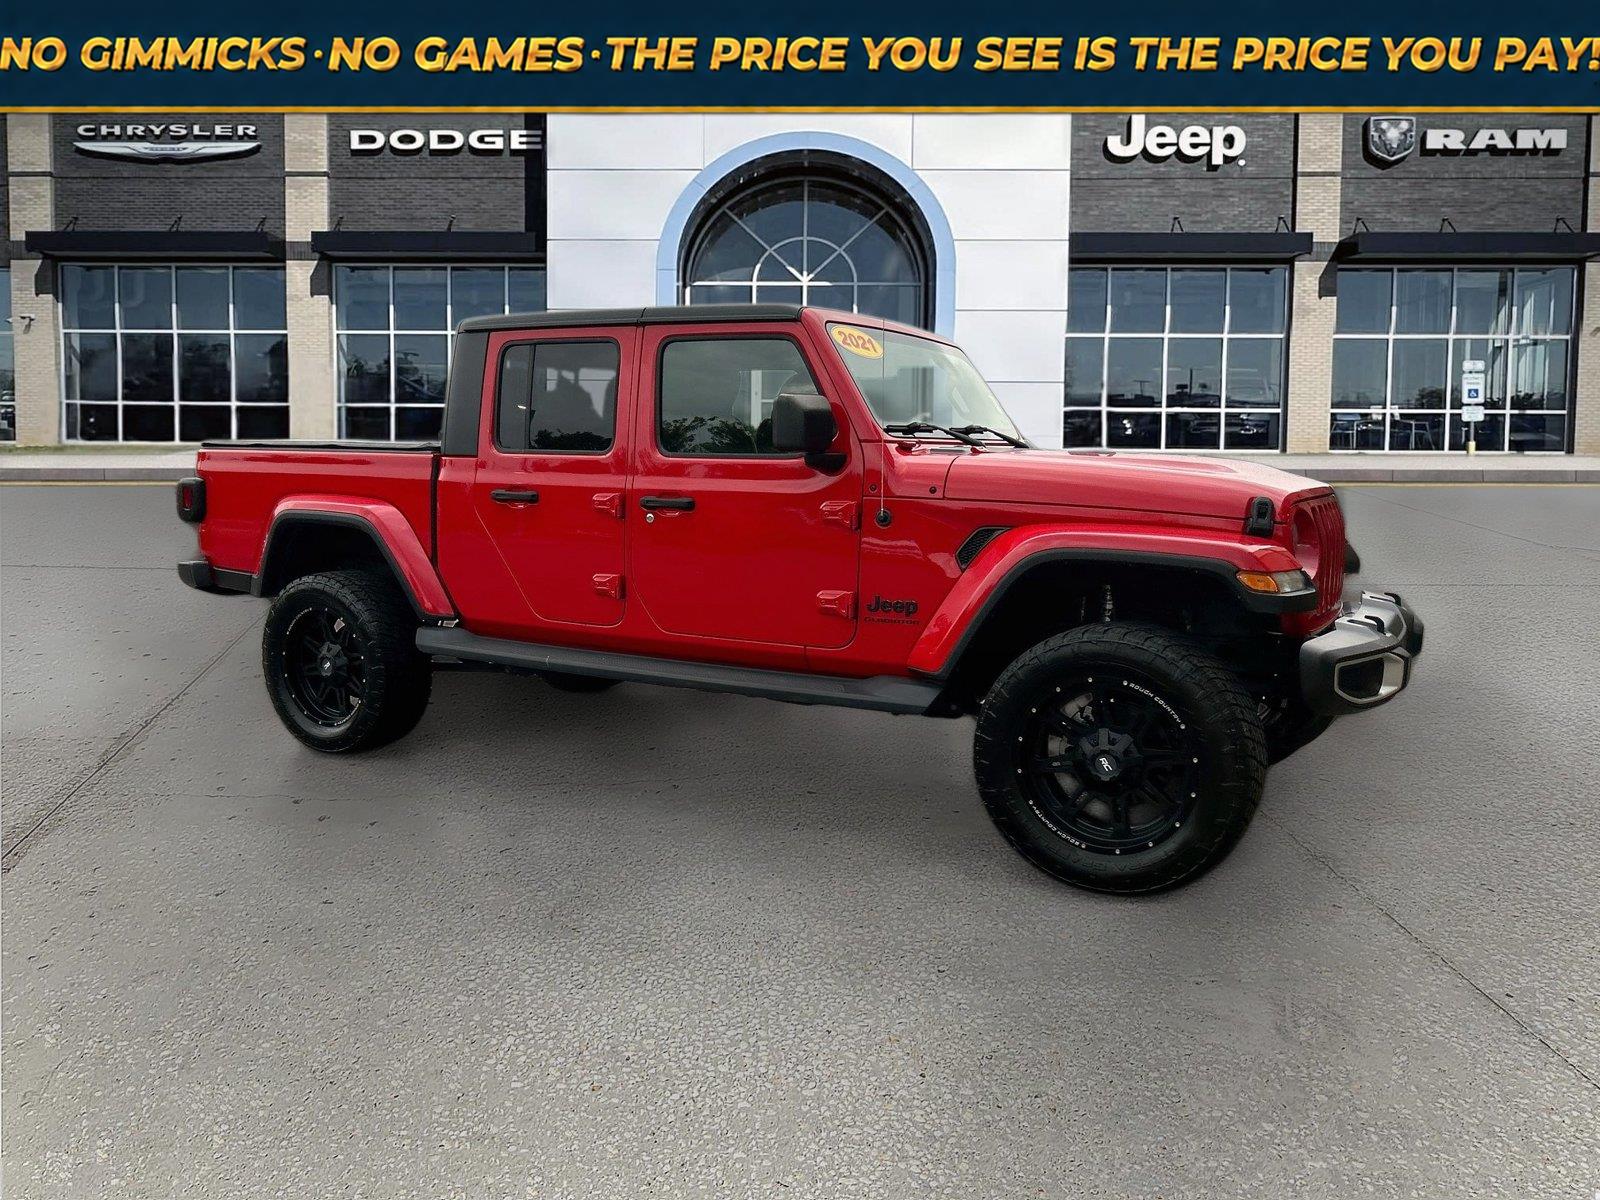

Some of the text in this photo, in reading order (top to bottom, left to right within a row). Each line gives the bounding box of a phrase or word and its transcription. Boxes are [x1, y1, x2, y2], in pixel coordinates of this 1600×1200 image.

[77, 124, 257, 136] CHRYSLER
[350, 129, 543, 151] DODGE
[1106, 114, 1247, 165] Jeep
[1425, 128, 1568, 150] RAM
[837, 330, 879, 353] 2021
[866, 595, 919, 617] Jeep
[1129, 682, 1181, 723] ROUGH COUNTRY
